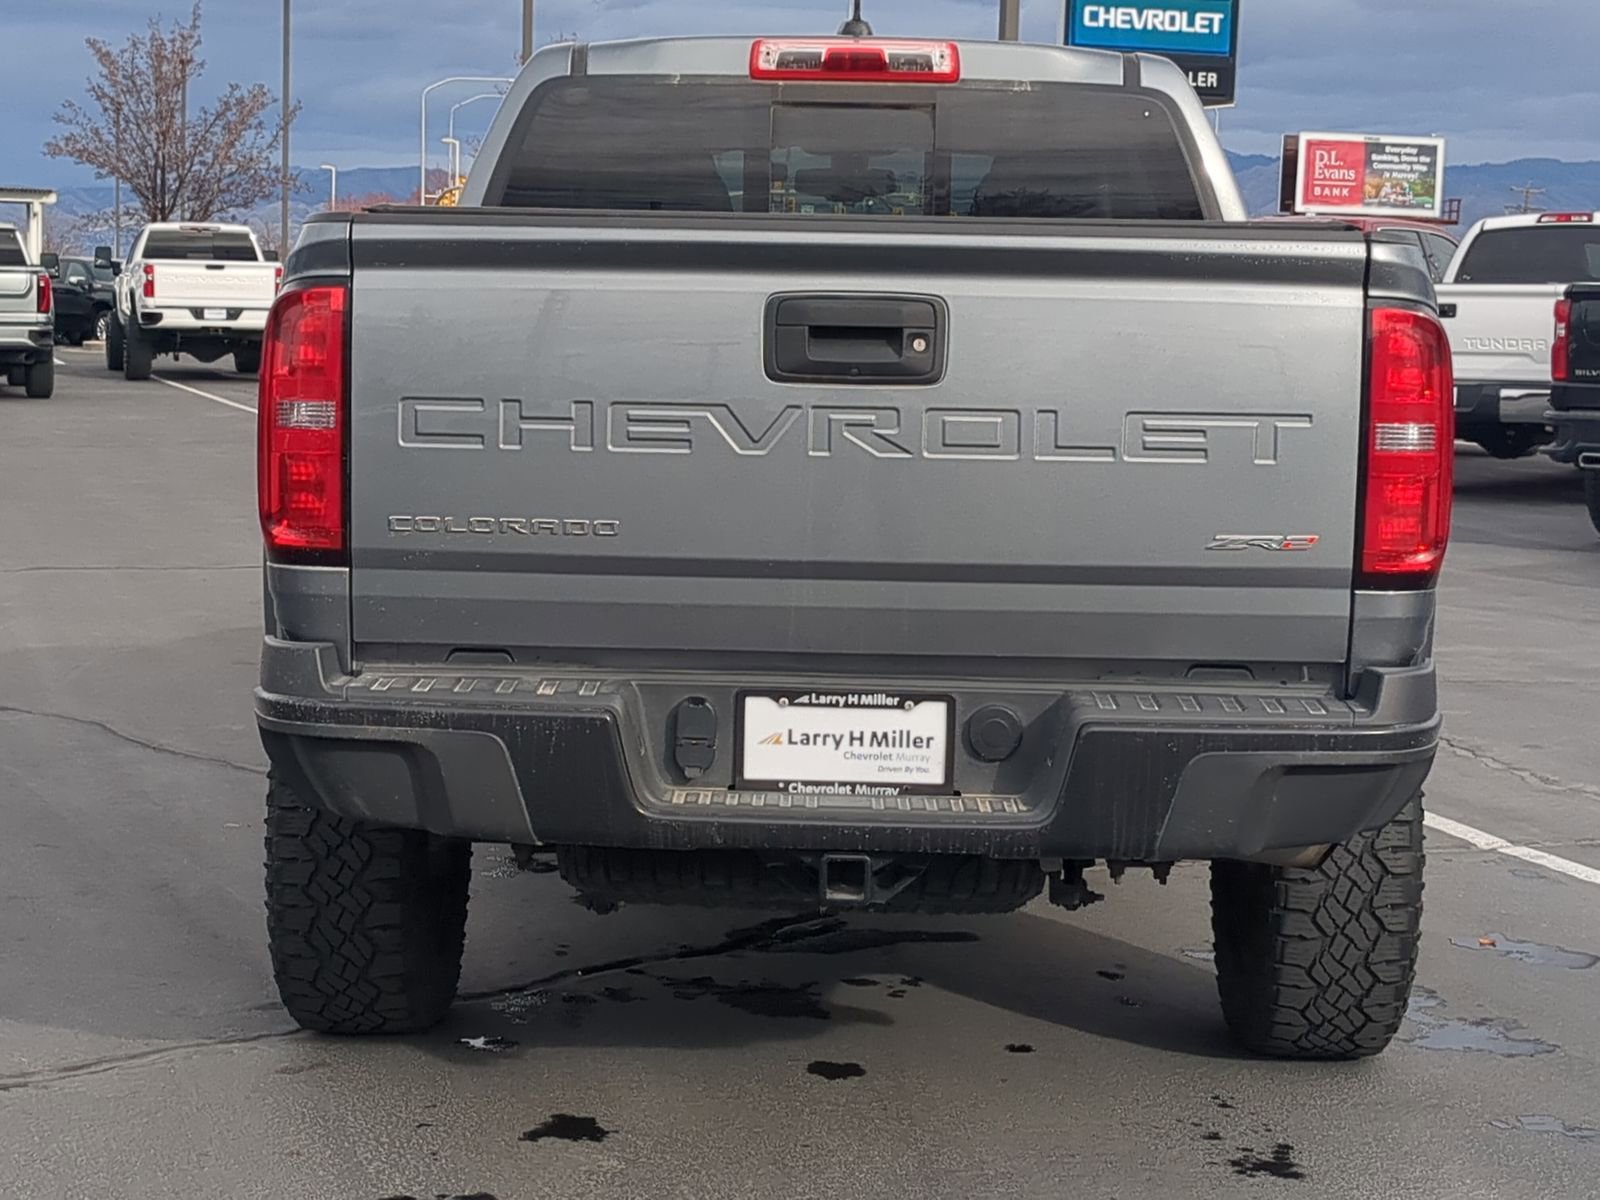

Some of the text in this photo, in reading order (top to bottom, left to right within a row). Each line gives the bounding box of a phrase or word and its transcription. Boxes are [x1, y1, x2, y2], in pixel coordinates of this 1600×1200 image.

[1083, 5, 1224, 34] CHEVROLET
[1385, 145, 1418, 155] Everyday
[1315, 150, 1344, 166] D.L.
[1314, 165, 1356, 180] Evans
[1314, 186, 1350, 197] BANK
[1463, 337, 1548, 351] TUNDRA
[399, 396, 1313, 466] CHEVROLET
[388, 515, 620, 537] COLORADO
[1204, 533, 1320, 551] ZR2
[811, 692, 900, 707] Larry H Miller
[787, 728, 934, 751] Larry H Miller
[843, 751, 930, 764] Chevrolet Murray
[877, 765, 903, 773] Driven
[904, 765, 914, 775] By
[788, 782, 900, 797] Chevrolet Murray
